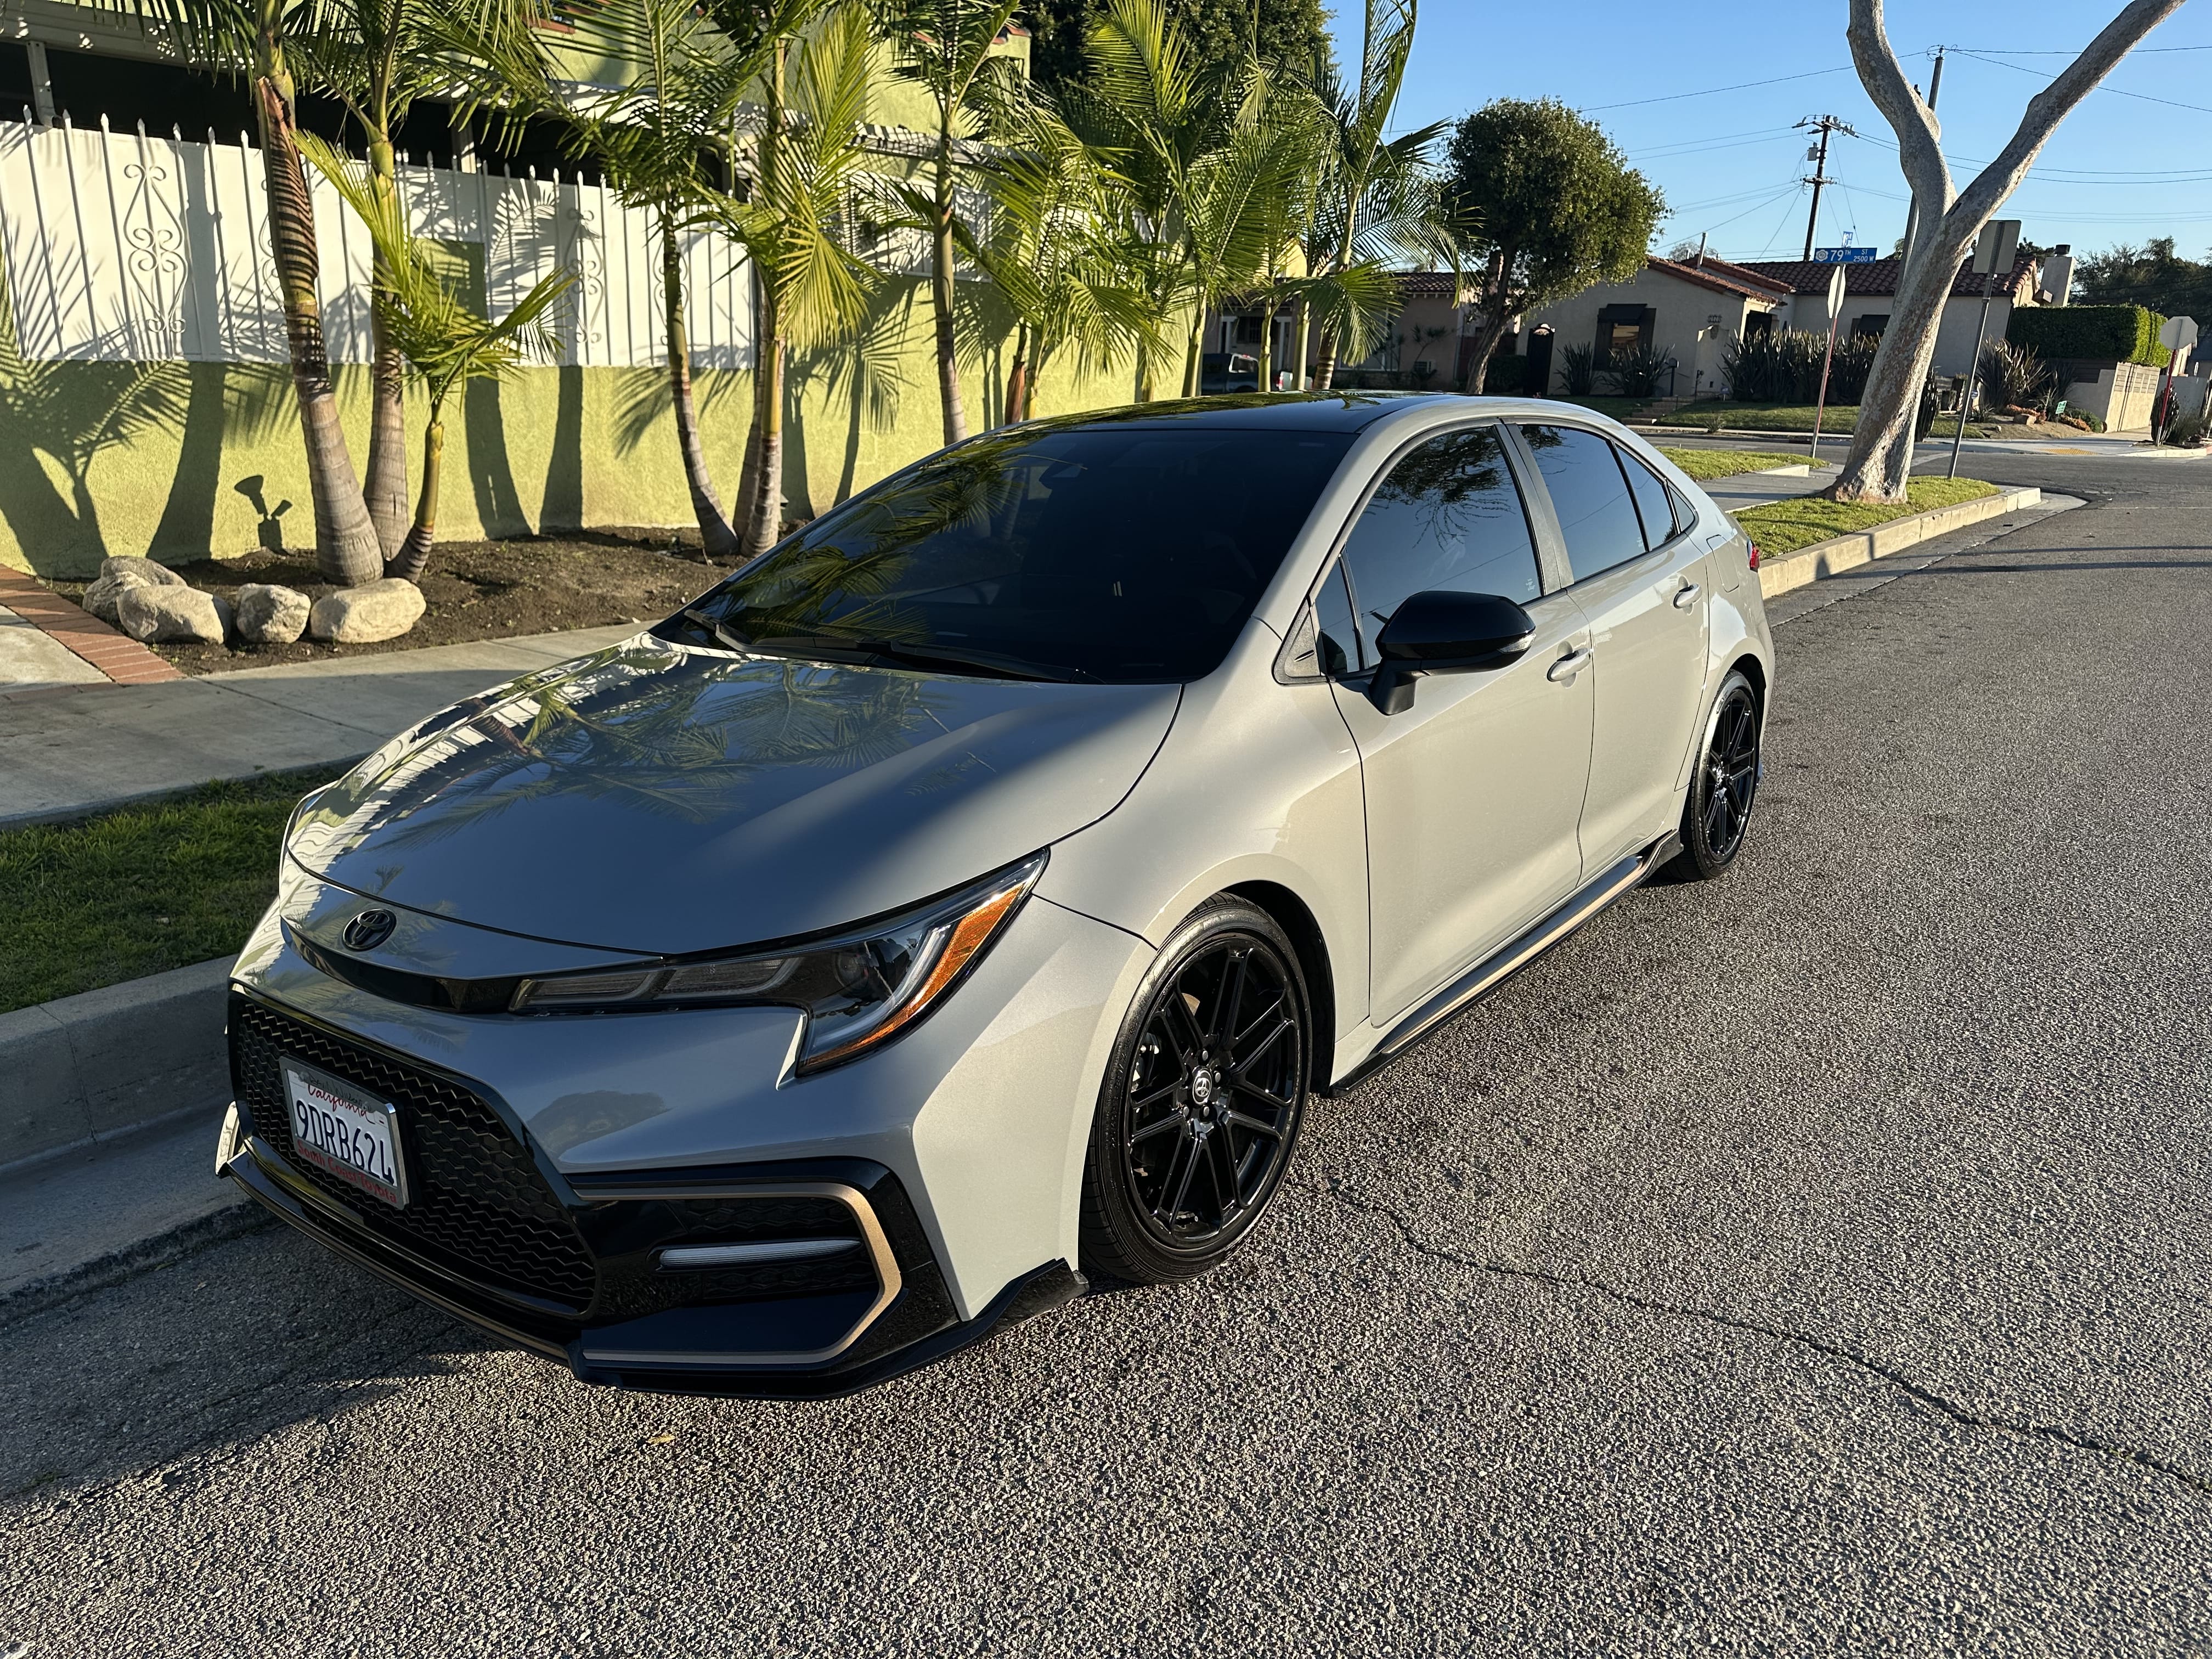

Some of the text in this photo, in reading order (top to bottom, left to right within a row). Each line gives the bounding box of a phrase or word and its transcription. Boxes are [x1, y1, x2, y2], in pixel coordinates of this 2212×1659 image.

[296, 1100, 394, 1186] 9DRB624
[297, 1139, 397, 1203] South Coast Toyota
